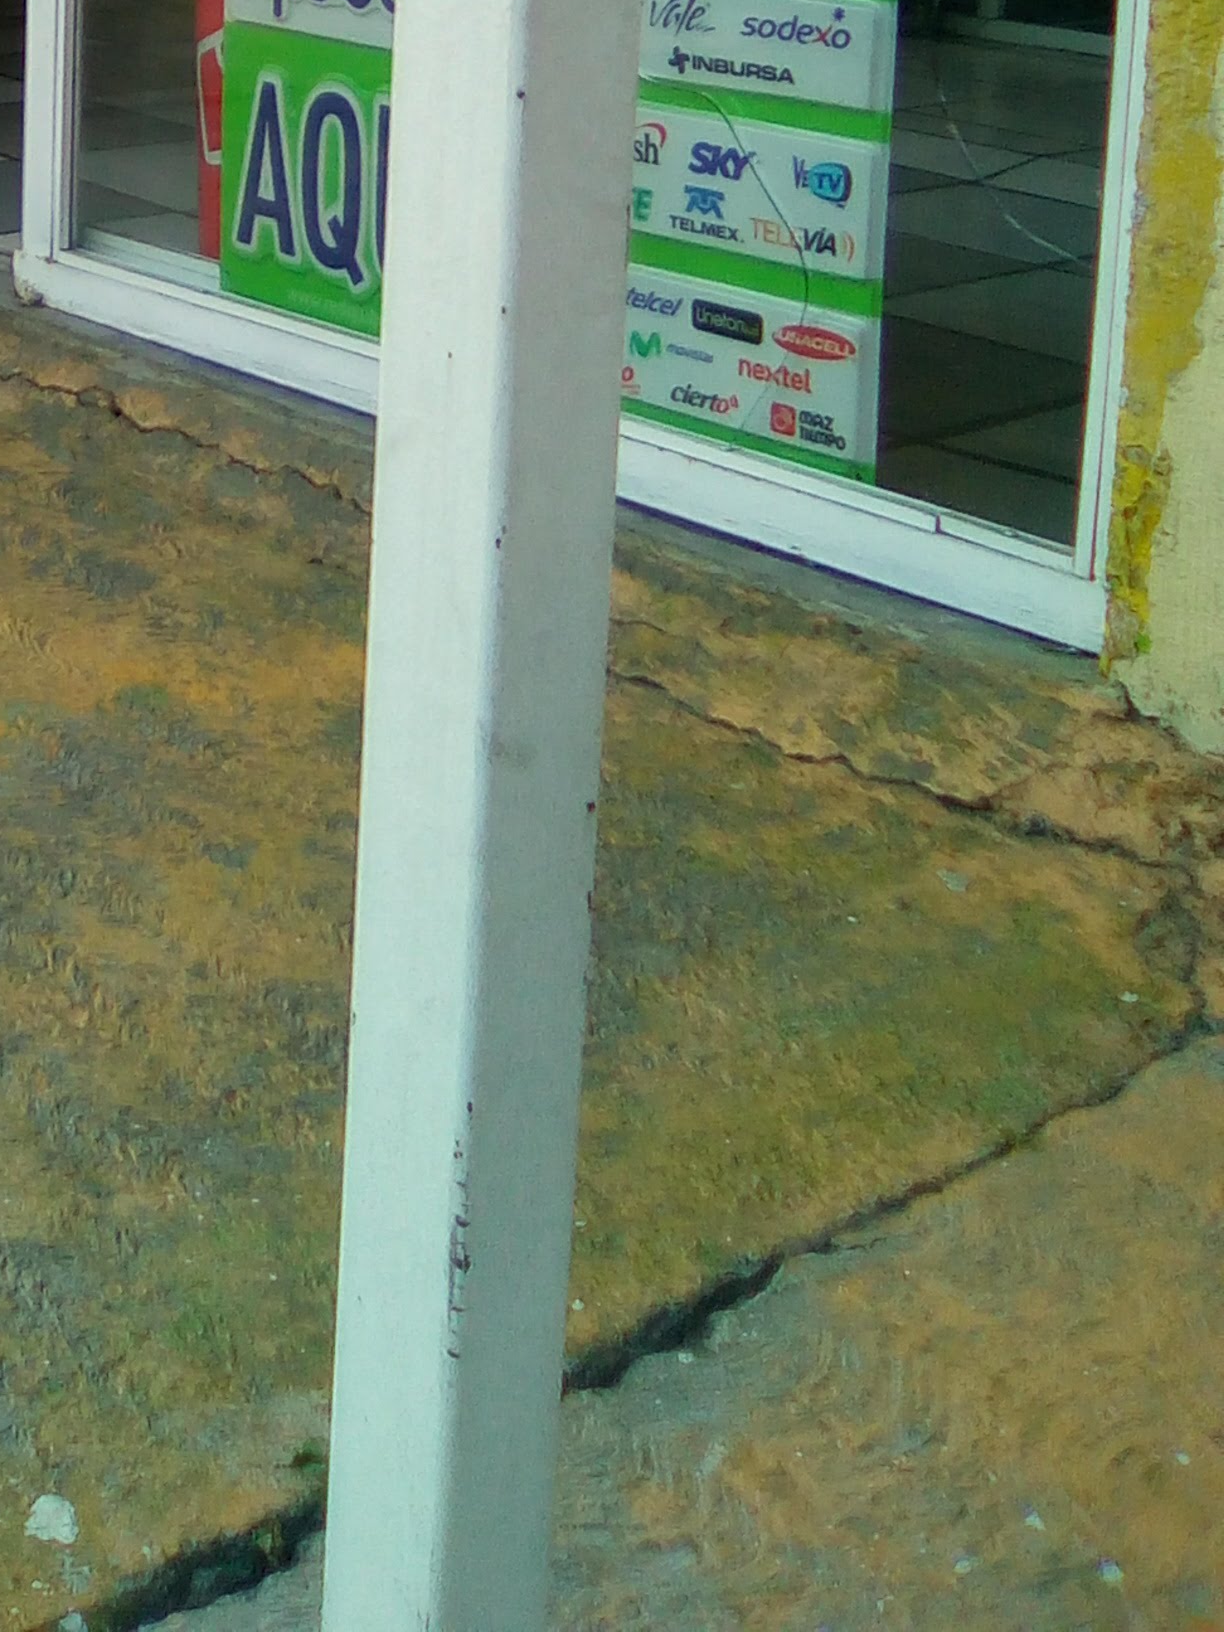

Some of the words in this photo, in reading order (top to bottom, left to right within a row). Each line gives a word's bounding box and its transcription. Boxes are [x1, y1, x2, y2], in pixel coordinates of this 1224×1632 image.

[740, 14, 852, 50] sodexo
[692, 55, 796, 86] INBURSA
[687, 141, 752, 181] SKY
[669, 214, 740, 243] TELMEX
[738, 358, 813, 394] nextel
[669, 383, 730, 414] cierto
